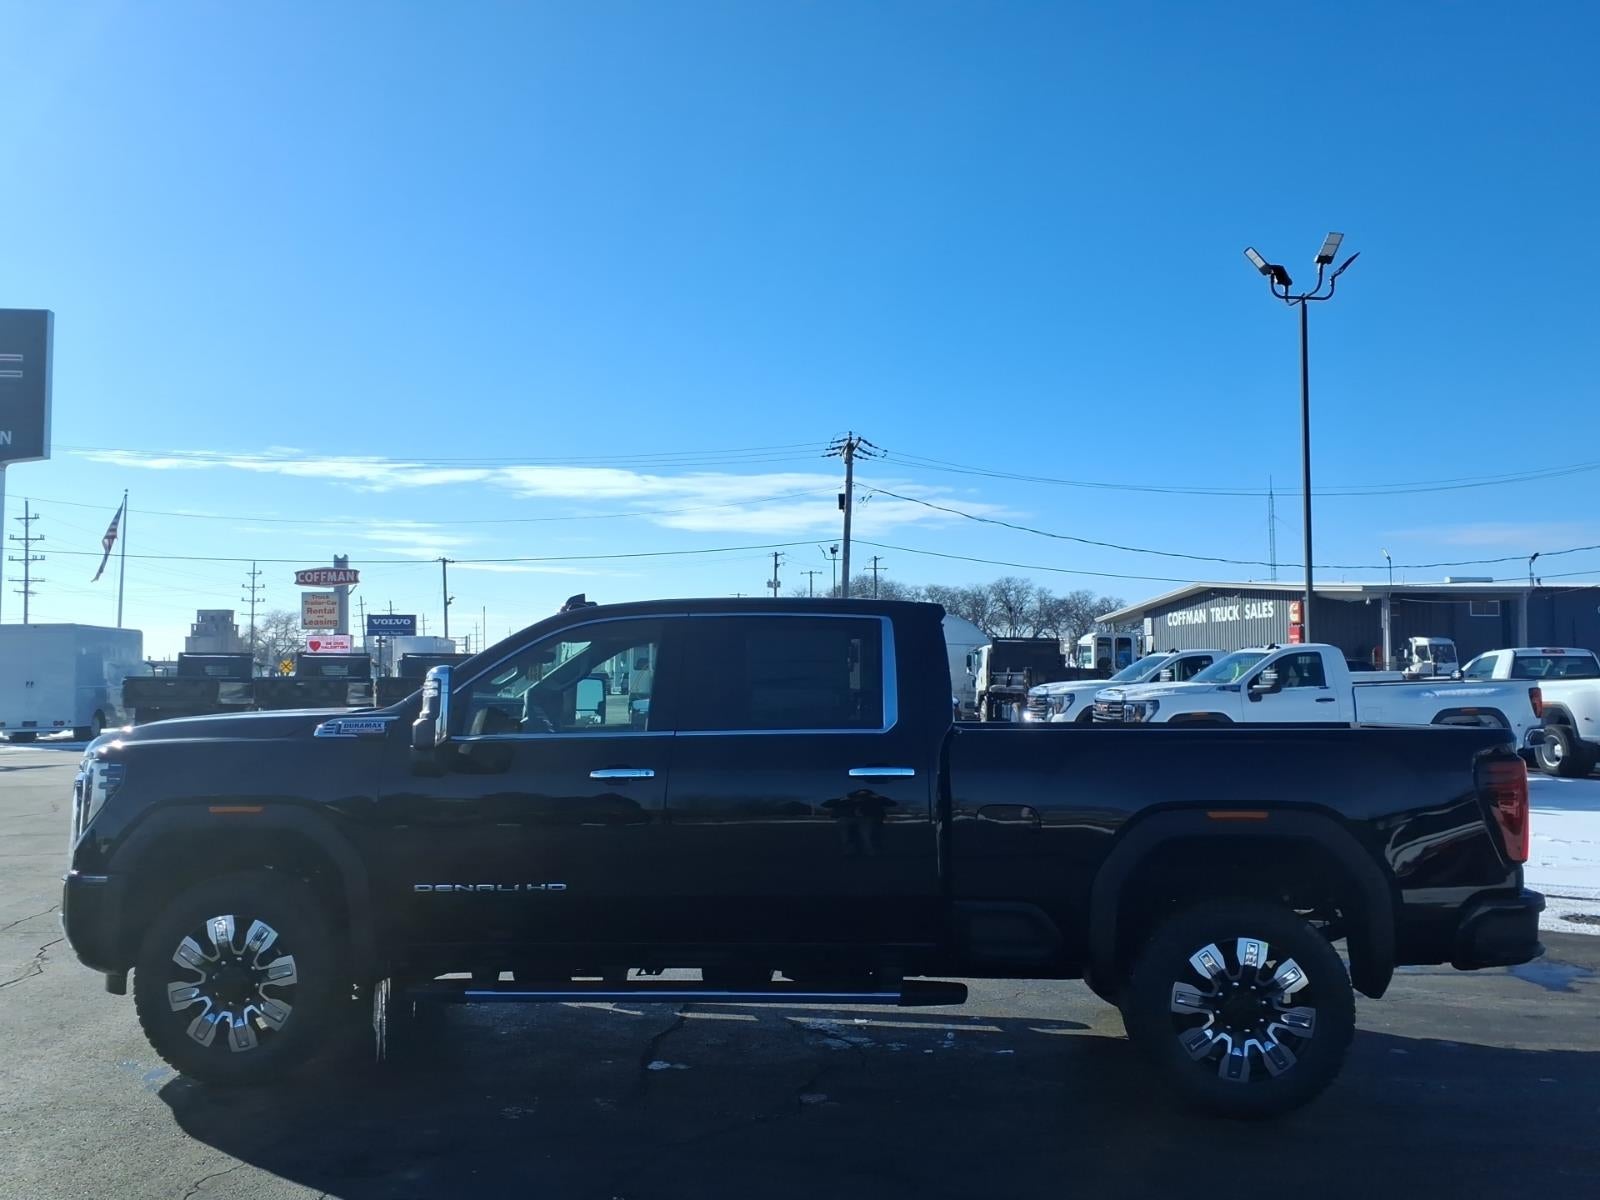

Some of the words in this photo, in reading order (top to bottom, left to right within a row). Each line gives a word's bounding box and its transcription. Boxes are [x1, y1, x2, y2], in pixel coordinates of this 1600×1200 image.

[298, 571, 355, 582] COFFMAN
[306, 607, 336, 615] Rental
[1167, 608, 1207, 627] COFFMAN
[1210, 604, 1240, 623] TRUCK
[1244, 601, 1274, 620] SALES
[303, 618, 338, 627] Leasing
[414, 884, 520, 892] DENALI
[526, 883, 567, 891] HD
